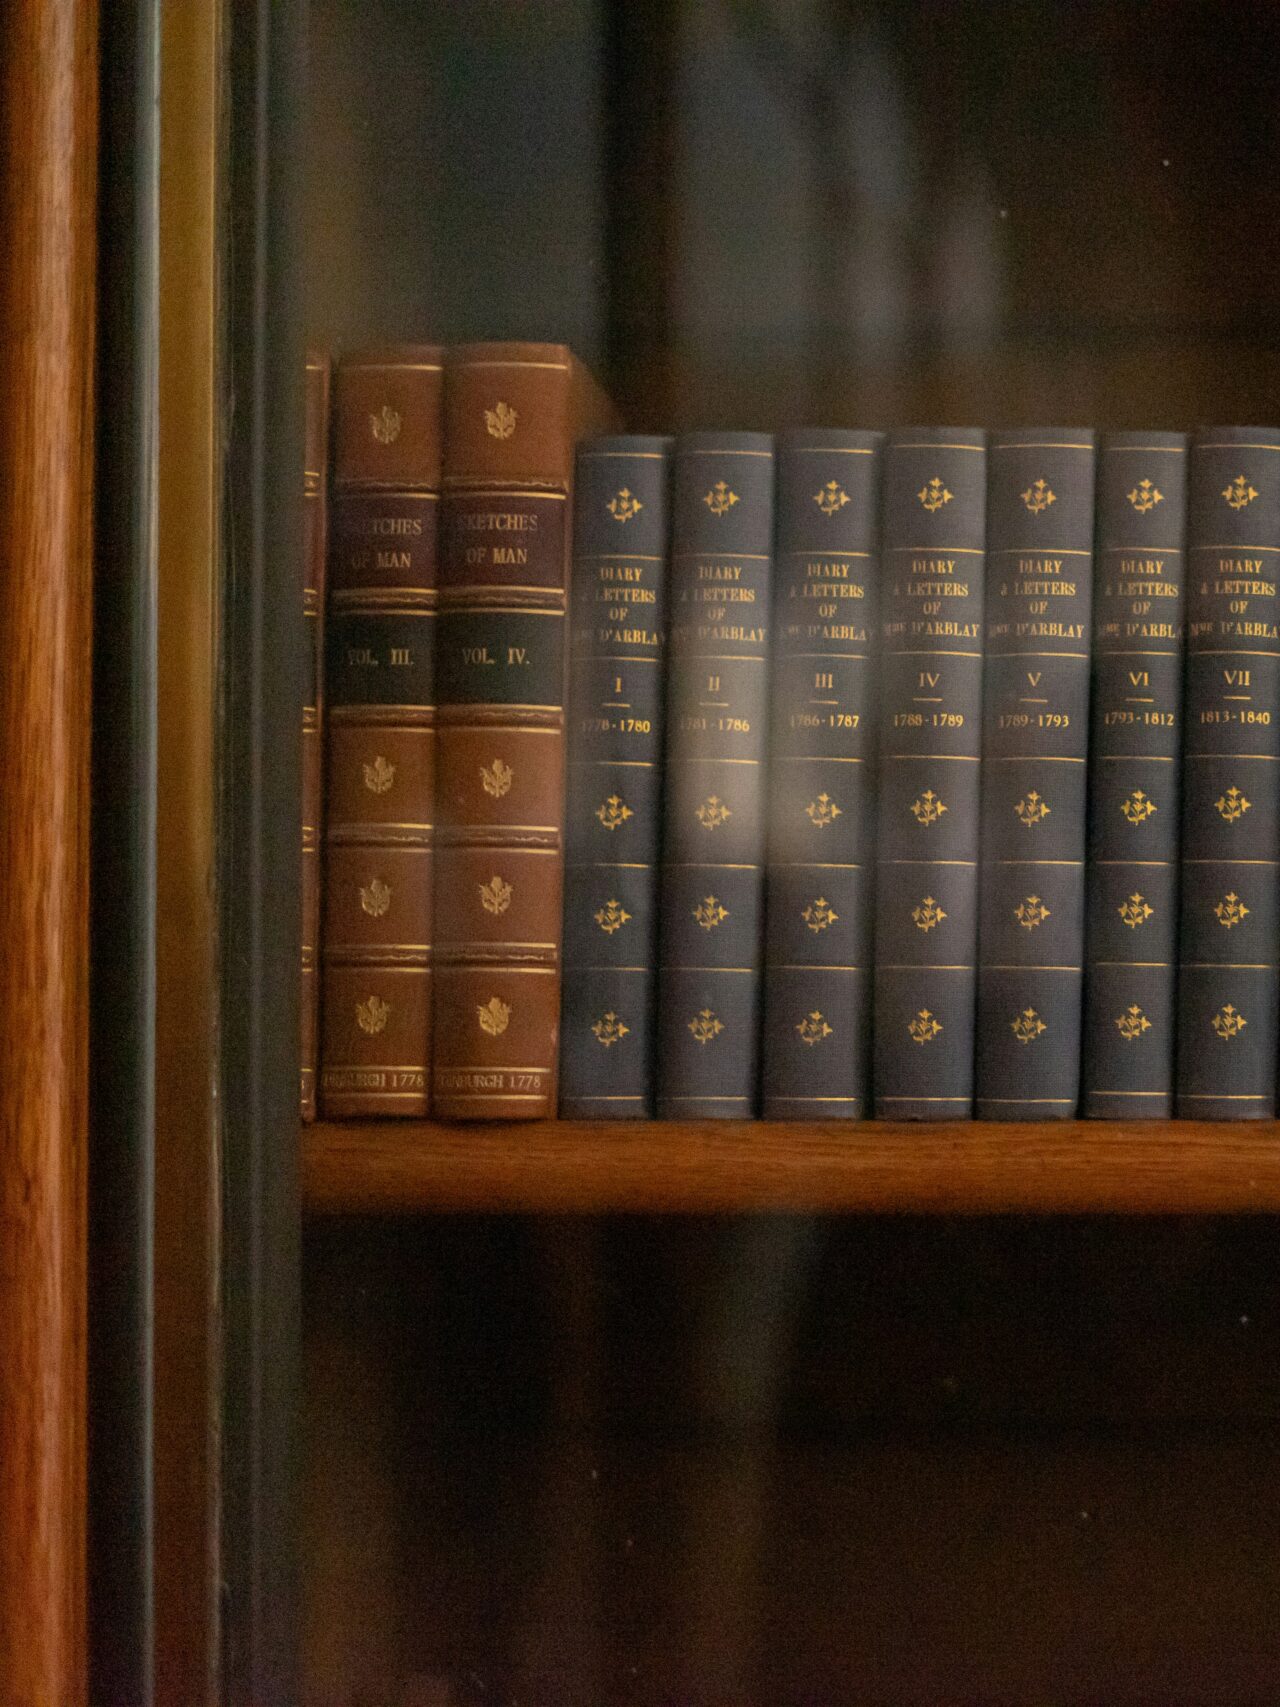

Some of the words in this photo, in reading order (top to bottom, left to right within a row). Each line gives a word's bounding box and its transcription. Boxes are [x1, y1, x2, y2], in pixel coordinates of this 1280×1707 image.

[378, 553, 412, 568] MAN
[493, 548, 528, 564] MAN
[699, 566, 742, 580] DIARY
[807, 563, 850, 578] DIARY
[912, 560, 955, 575] DIARY
[1019, 559, 1062, 574] DIARY
[1121, 559, 1164, 575] DIARY
[1219, 559, 1263, 574] DIARY
[601, 567, 642, 582] DIARY
[596, 588, 657, 604] LETTERS
[803, 584, 865, 599] LETTERS
[907, 582, 969, 598] LETTERS
[1015, 581, 1076, 597] LETTERS
[1118, 582, 1179, 598] LETTERS
[1215, 580, 1276, 597] LETTERS
[609, 607, 628, 621] OF
[707, 607, 726, 621] OF
[819, 603, 838, 618] OF
[923, 601, 941, 616] OF
[1029, 600, 1048, 615] OF
[1132, 601, 1151, 616] OF
[1229, 600, 1249, 615] OF
[912, 622, 980, 638] D'ARBLAY
[1017, 623, 1085, 639] D'ARBLAY
[615, 677, 622, 693] I
[708, 676, 720, 692] II
[815, 672, 834, 689] III
[919, 672, 941, 688] IV
[1027, 672, 1042, 687] V
[1129, 671, 1150, 687] VI
[1223, 670, 1251, 686] VII
[393, 1074, 425, 1088] 1778
[510, 1076, 542, 1088] 1778
